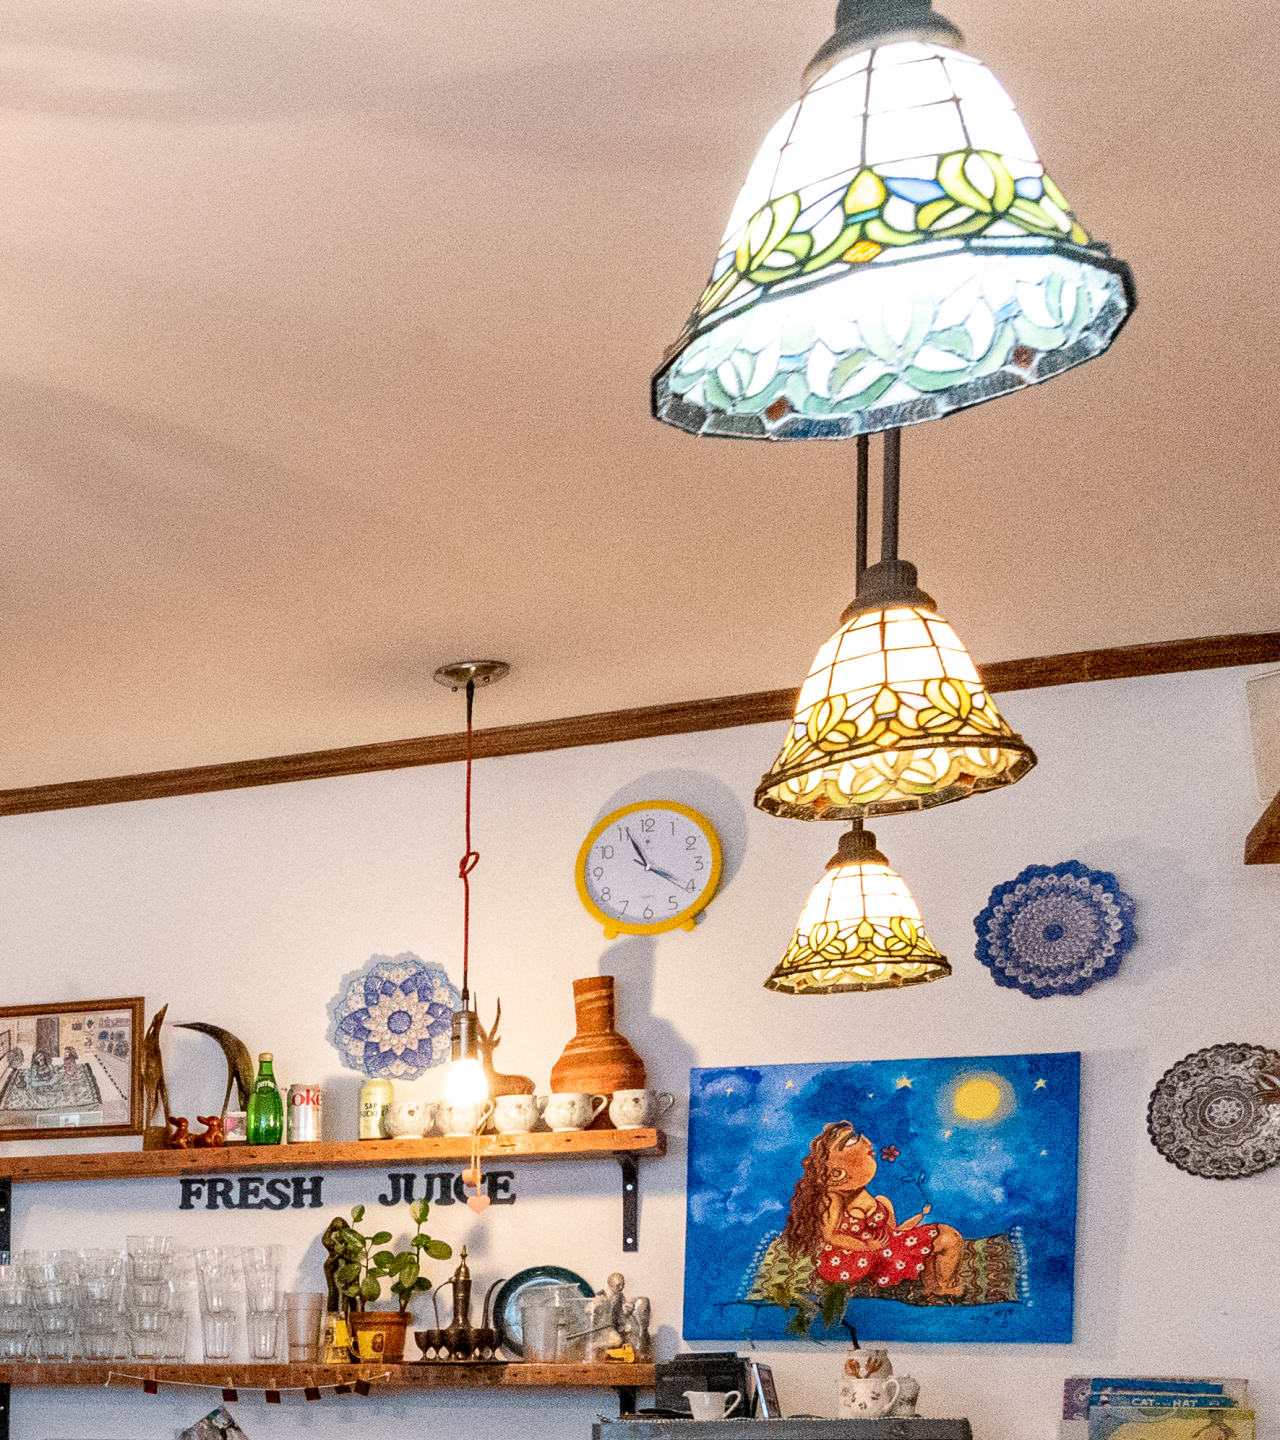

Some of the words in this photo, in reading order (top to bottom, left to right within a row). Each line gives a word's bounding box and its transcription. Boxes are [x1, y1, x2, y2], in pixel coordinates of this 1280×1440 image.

[640, 818, 656, 833] 12
[685, 835, 697, 851] 2
[600, 844, 615, 860] 10
[693, 855, 704, 871] 3
[593, 866, 604, 881] 9
[685, 878, 697, 892] 4
[600, 886, 612, 902] 8
[618, 899, 629, 916] 7
[668, 895, 679, 910] 5
[642, 904, 654, 920] 6
[178, 1175, 324, 1210] FRESH
[378, 1170, 517, 1207] JUICE
[1131, 1398, 1156, 1407] CAT
[1173, 1399, 1198, 1408] HAT
